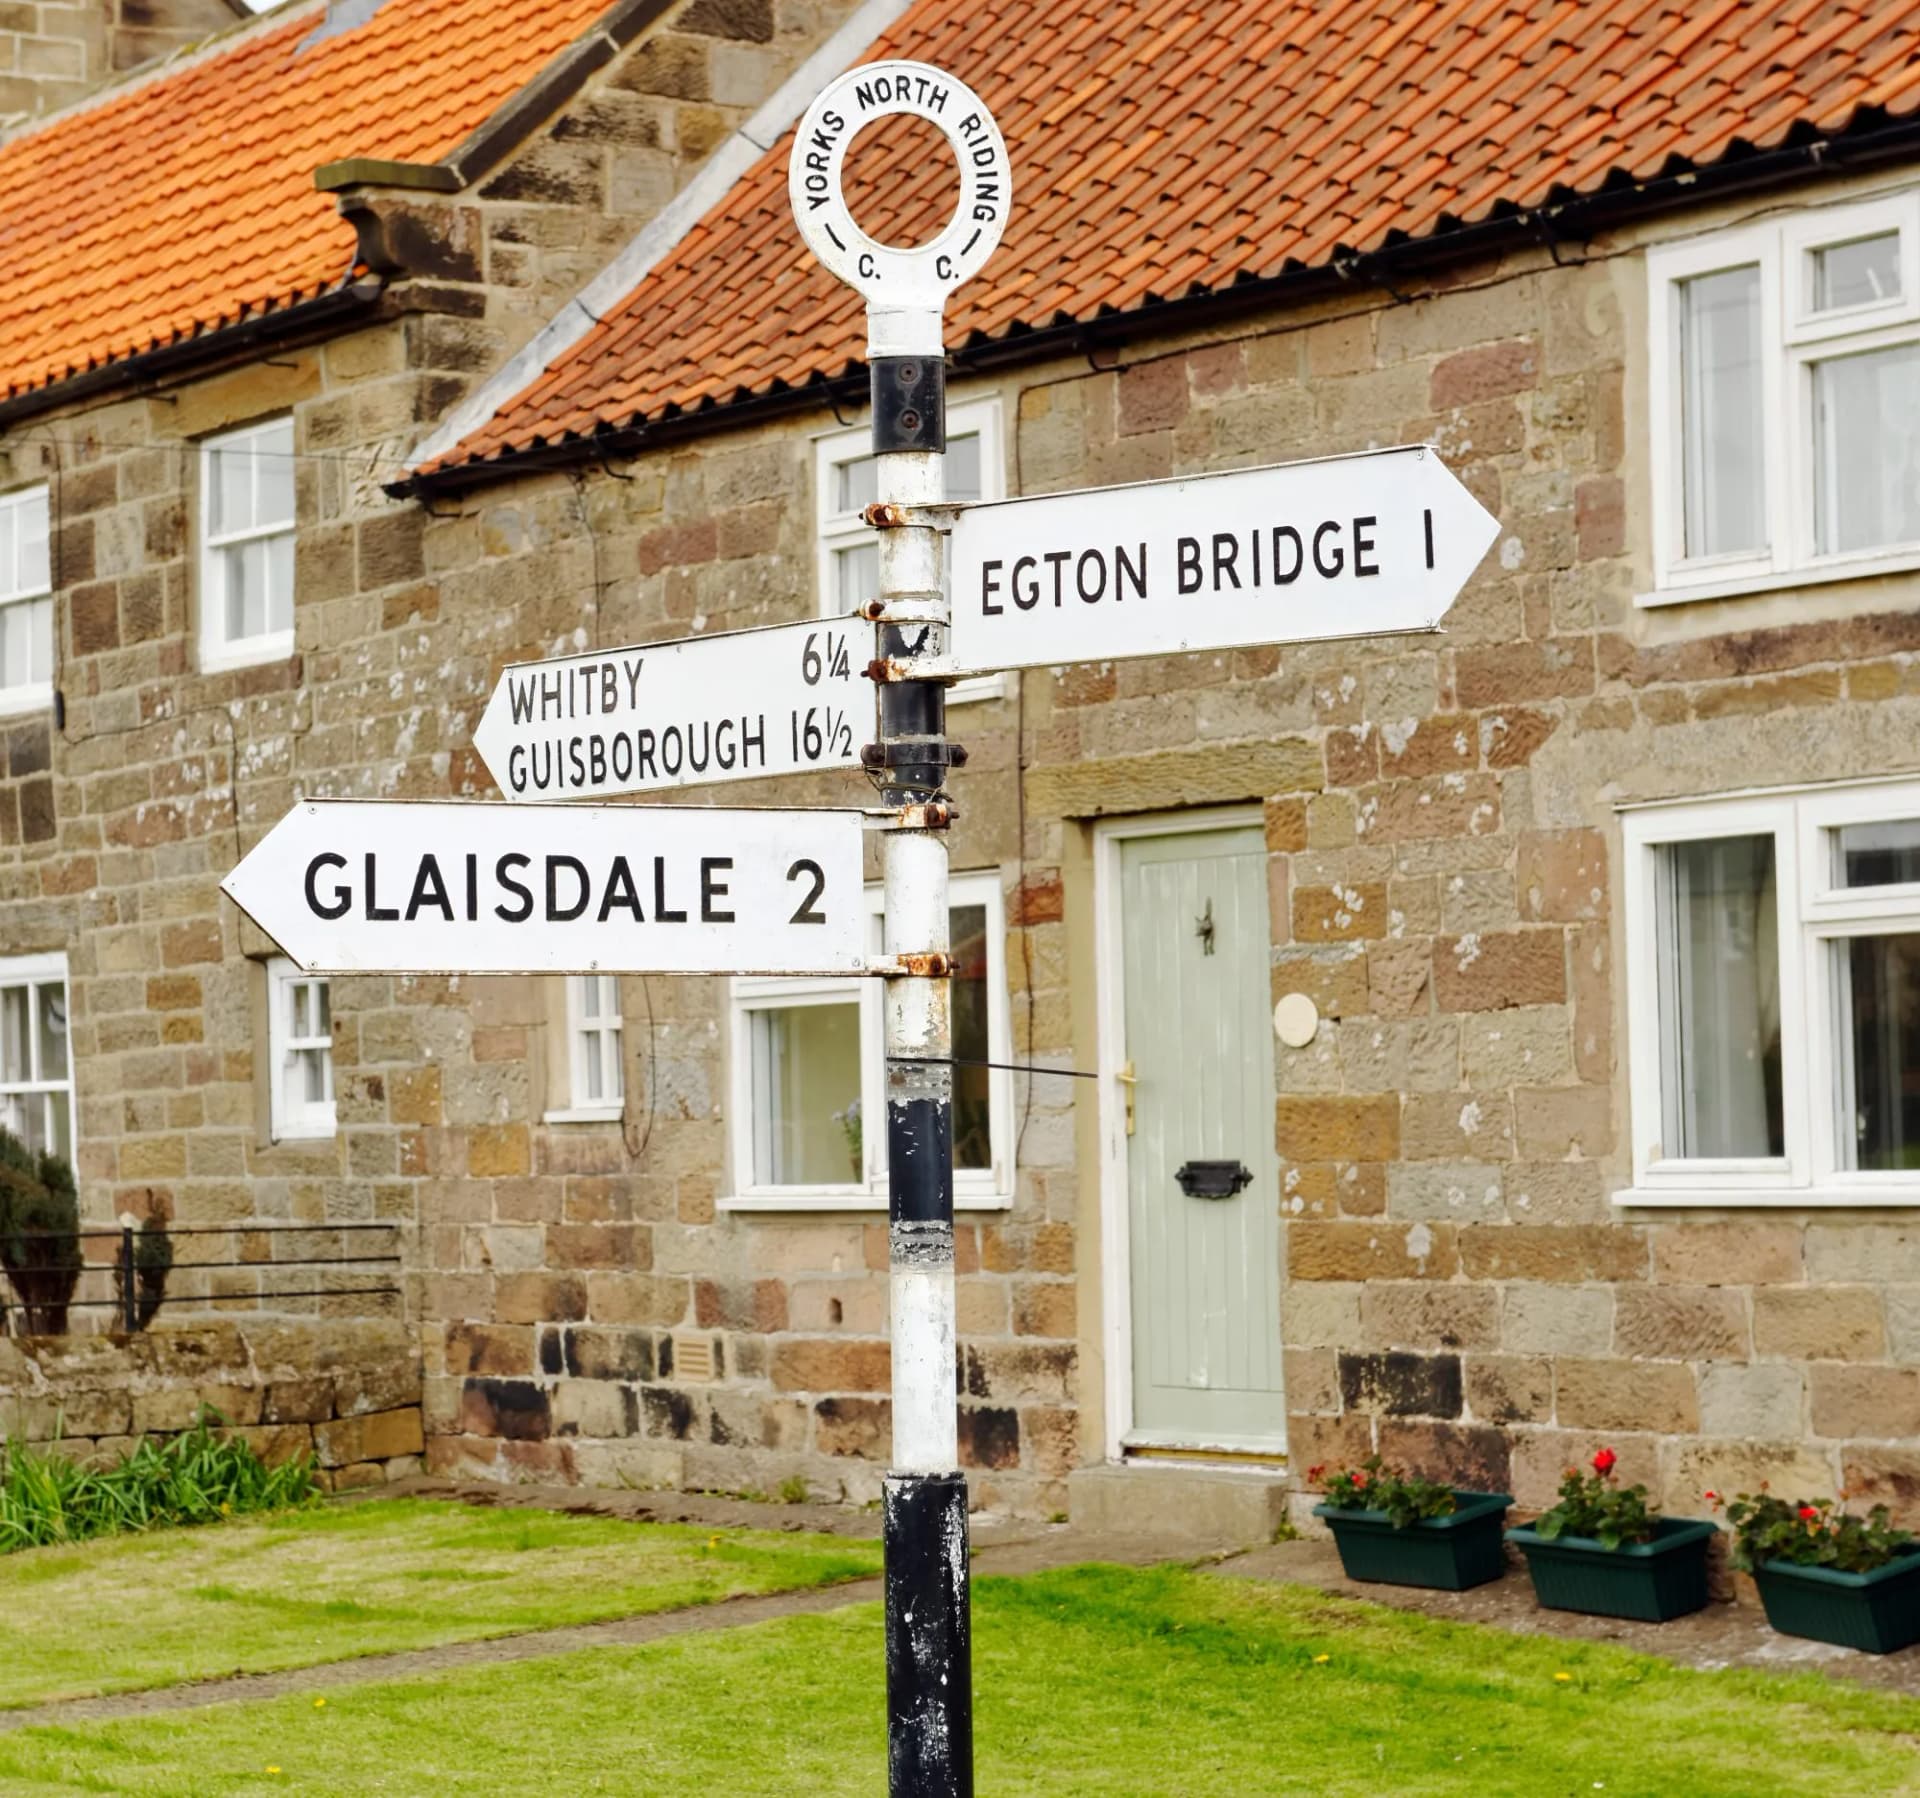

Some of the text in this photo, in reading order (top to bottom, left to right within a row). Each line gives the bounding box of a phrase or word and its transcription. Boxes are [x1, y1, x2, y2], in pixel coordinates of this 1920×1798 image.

[805, 75, 999, 222] YORKS NORTH RIDING
[982, 542, 1147, 616] EGTON
[1177, 515, 1380, 595] BRIDGE
[508, 657, 644, 725] WHITBY
[509, 713, 765, 793] GUISBOROUGH
[304, 852, 826, 925] GLAISDALE 2
